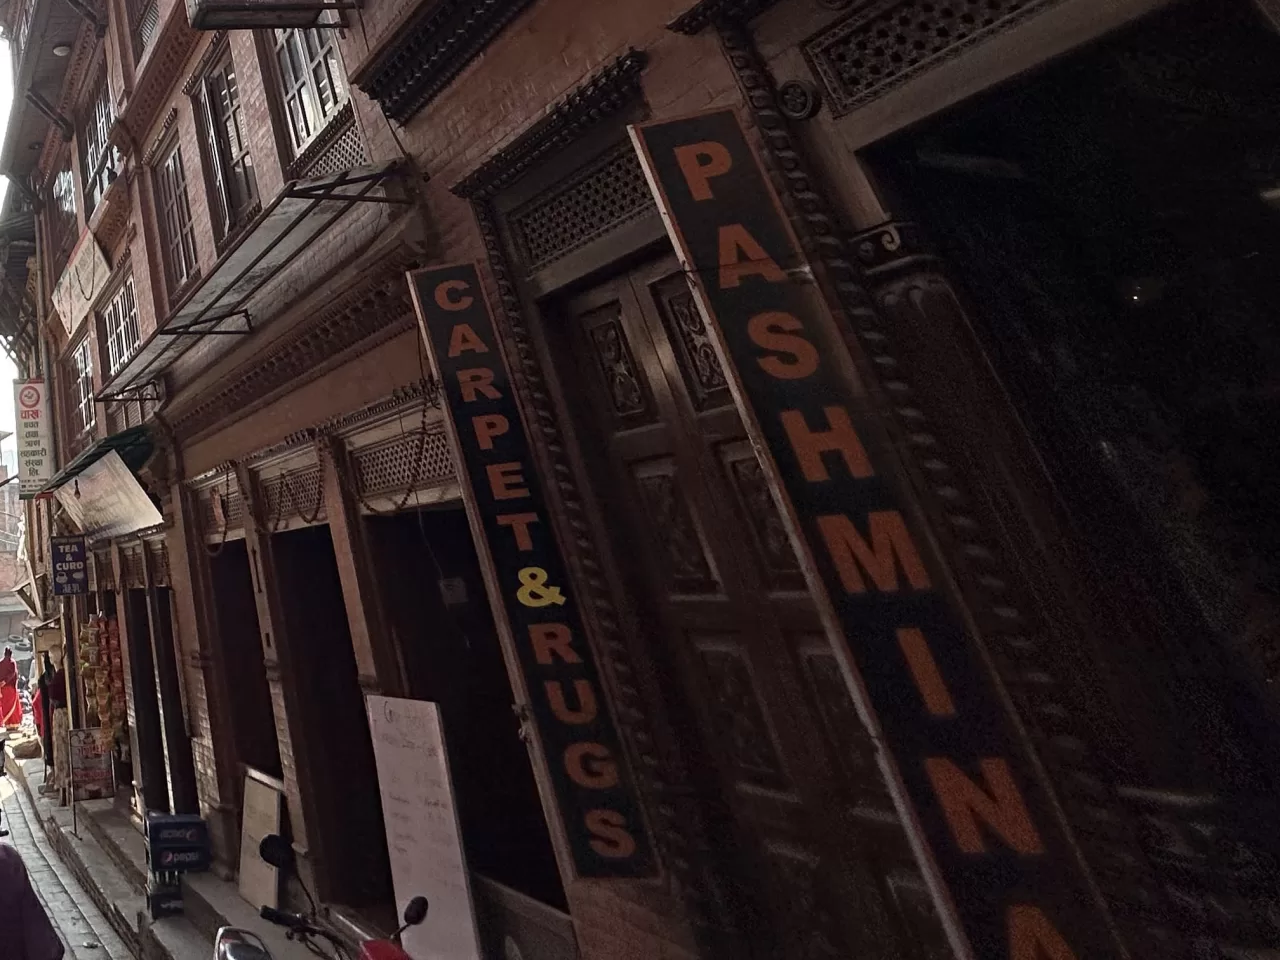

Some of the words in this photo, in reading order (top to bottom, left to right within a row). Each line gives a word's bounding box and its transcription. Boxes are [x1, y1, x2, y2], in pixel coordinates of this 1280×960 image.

[434, 279, 540, 552] CARPET
[58, 544, 79, 553] TEA
[65, 553, 73, 561] &
[516, 567, 567, 608] &
[528, 623, 637, 859] RUGS
[173, 851, 200, 864] pepsi
